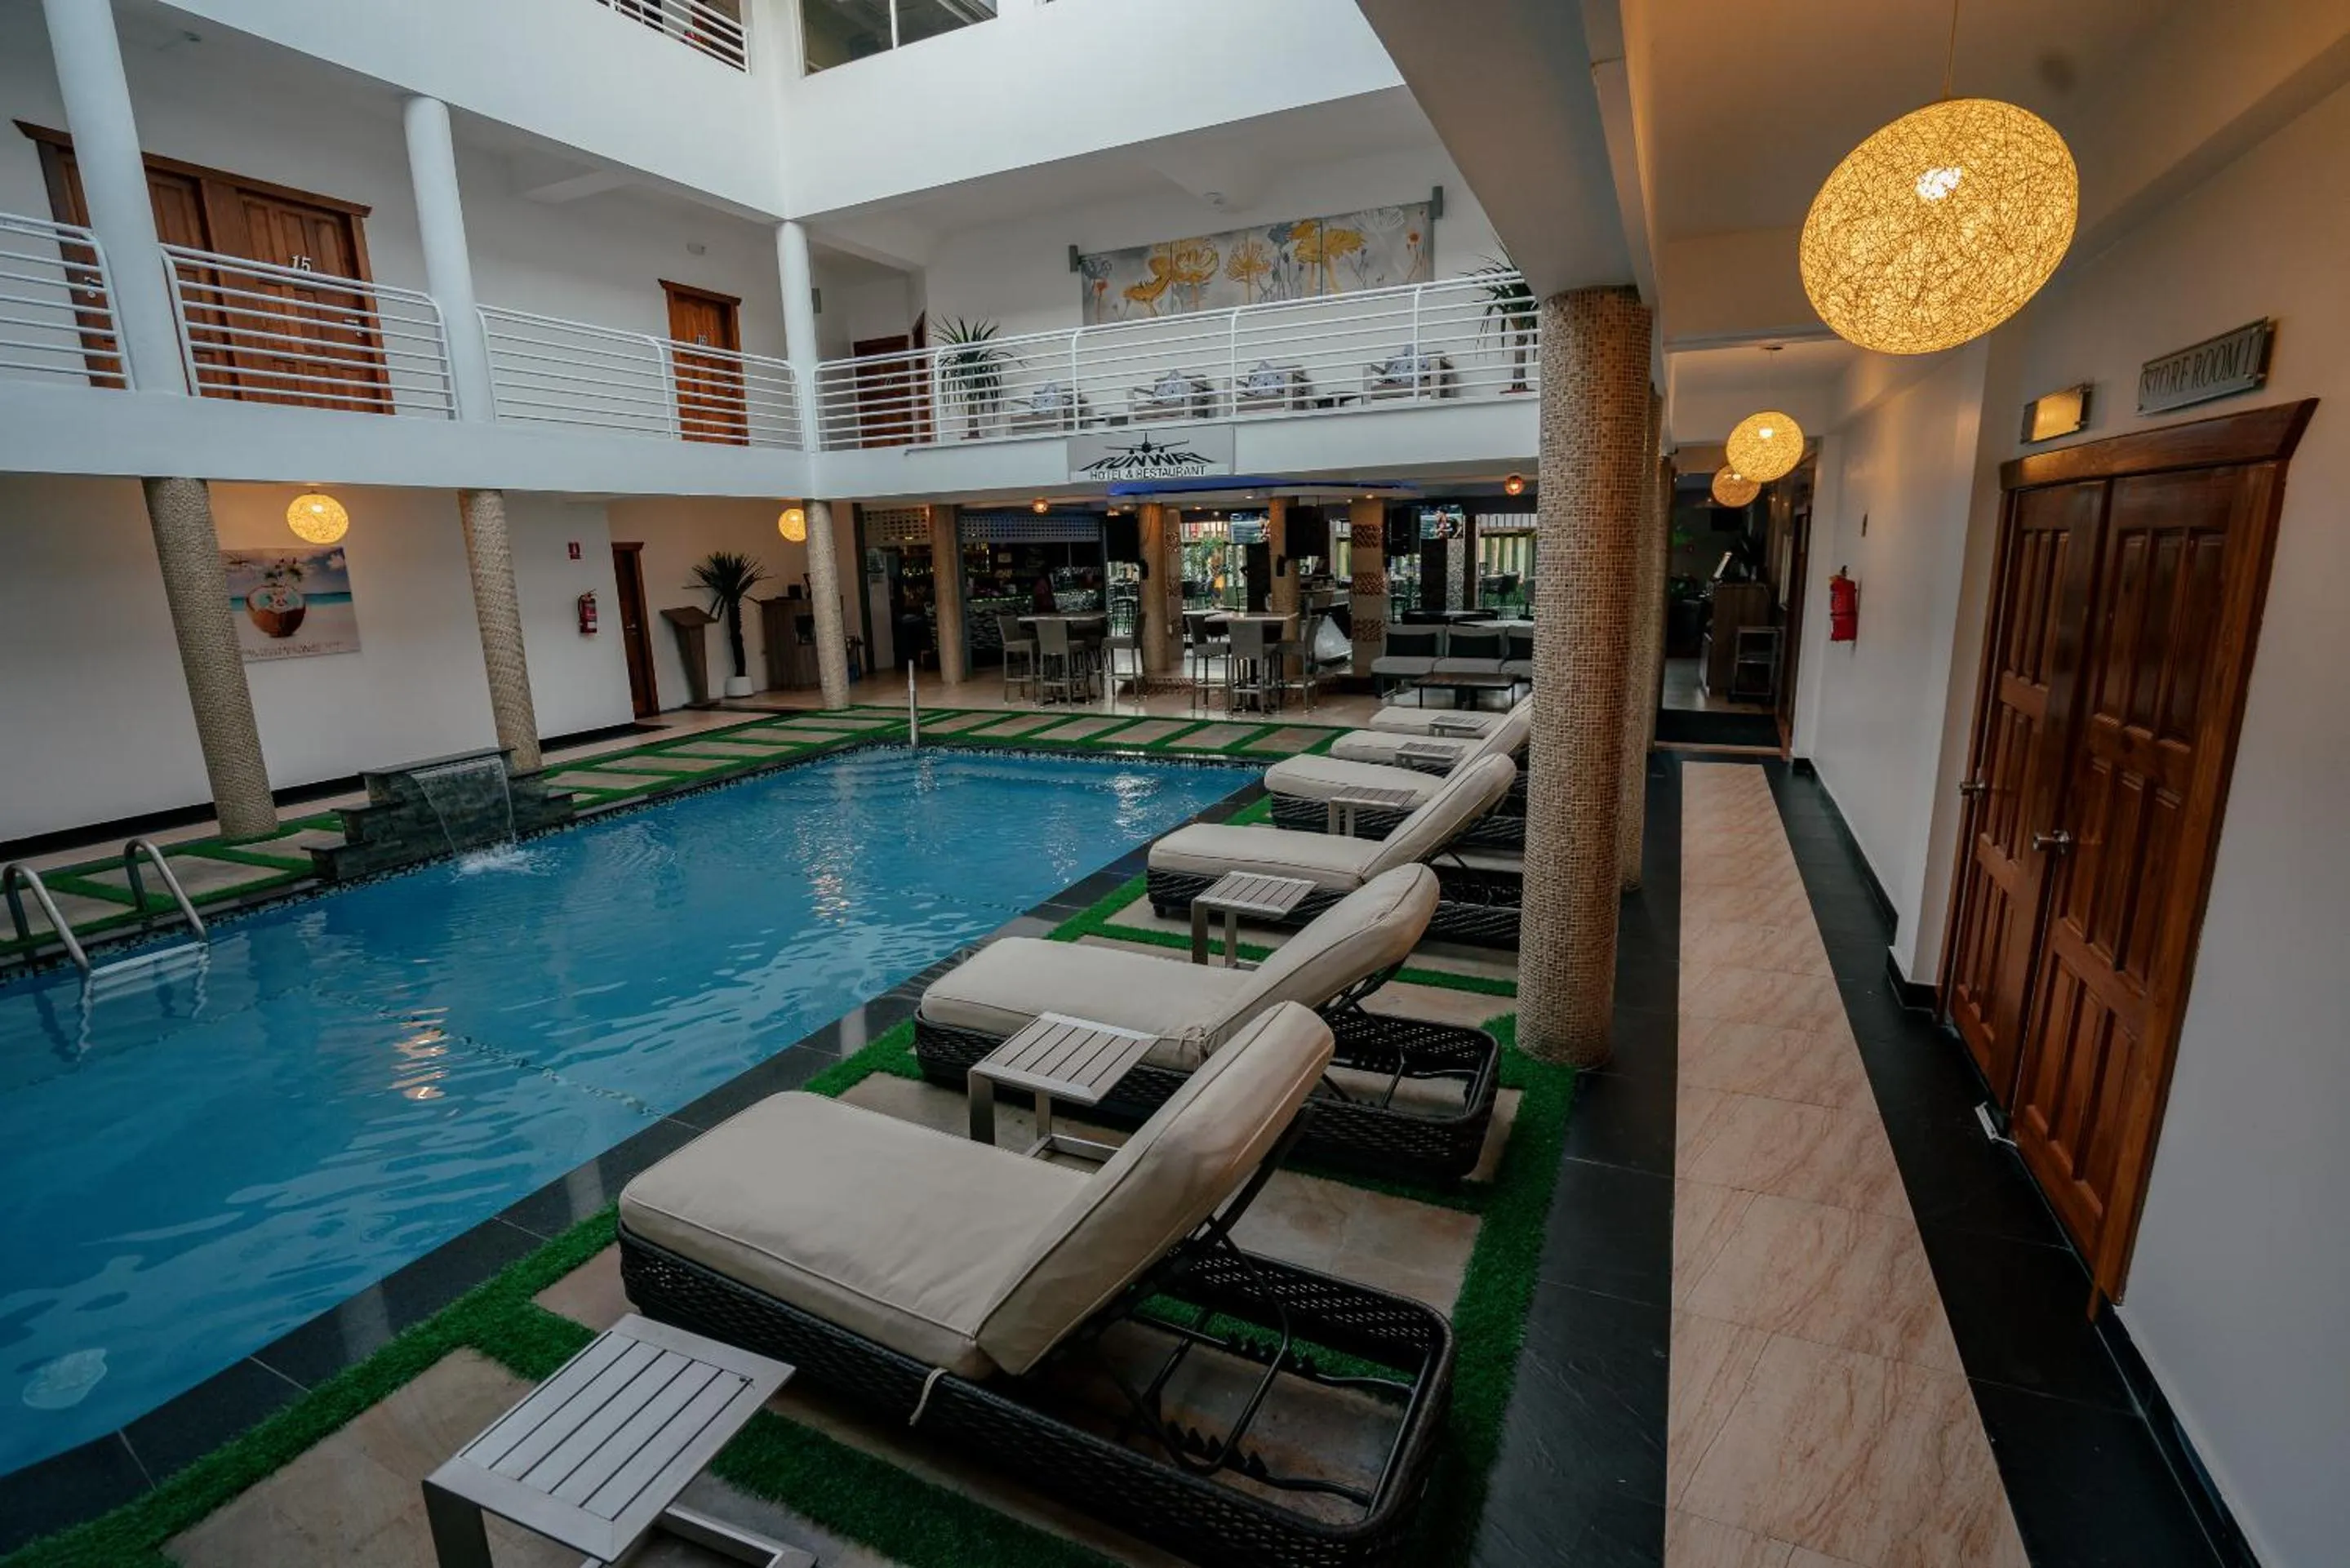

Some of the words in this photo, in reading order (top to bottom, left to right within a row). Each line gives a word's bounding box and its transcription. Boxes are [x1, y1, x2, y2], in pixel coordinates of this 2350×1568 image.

[291, 255, 311, 272] 15
[2140, 356, 2190, 397] STORE
[2192, 339, 2243, 389] ROOM
[1090, 469, 1122, 480] HOTEL
[1126, 469, 1135, 478] &
[1137, 466, 1206, 479] RESTAURANT
